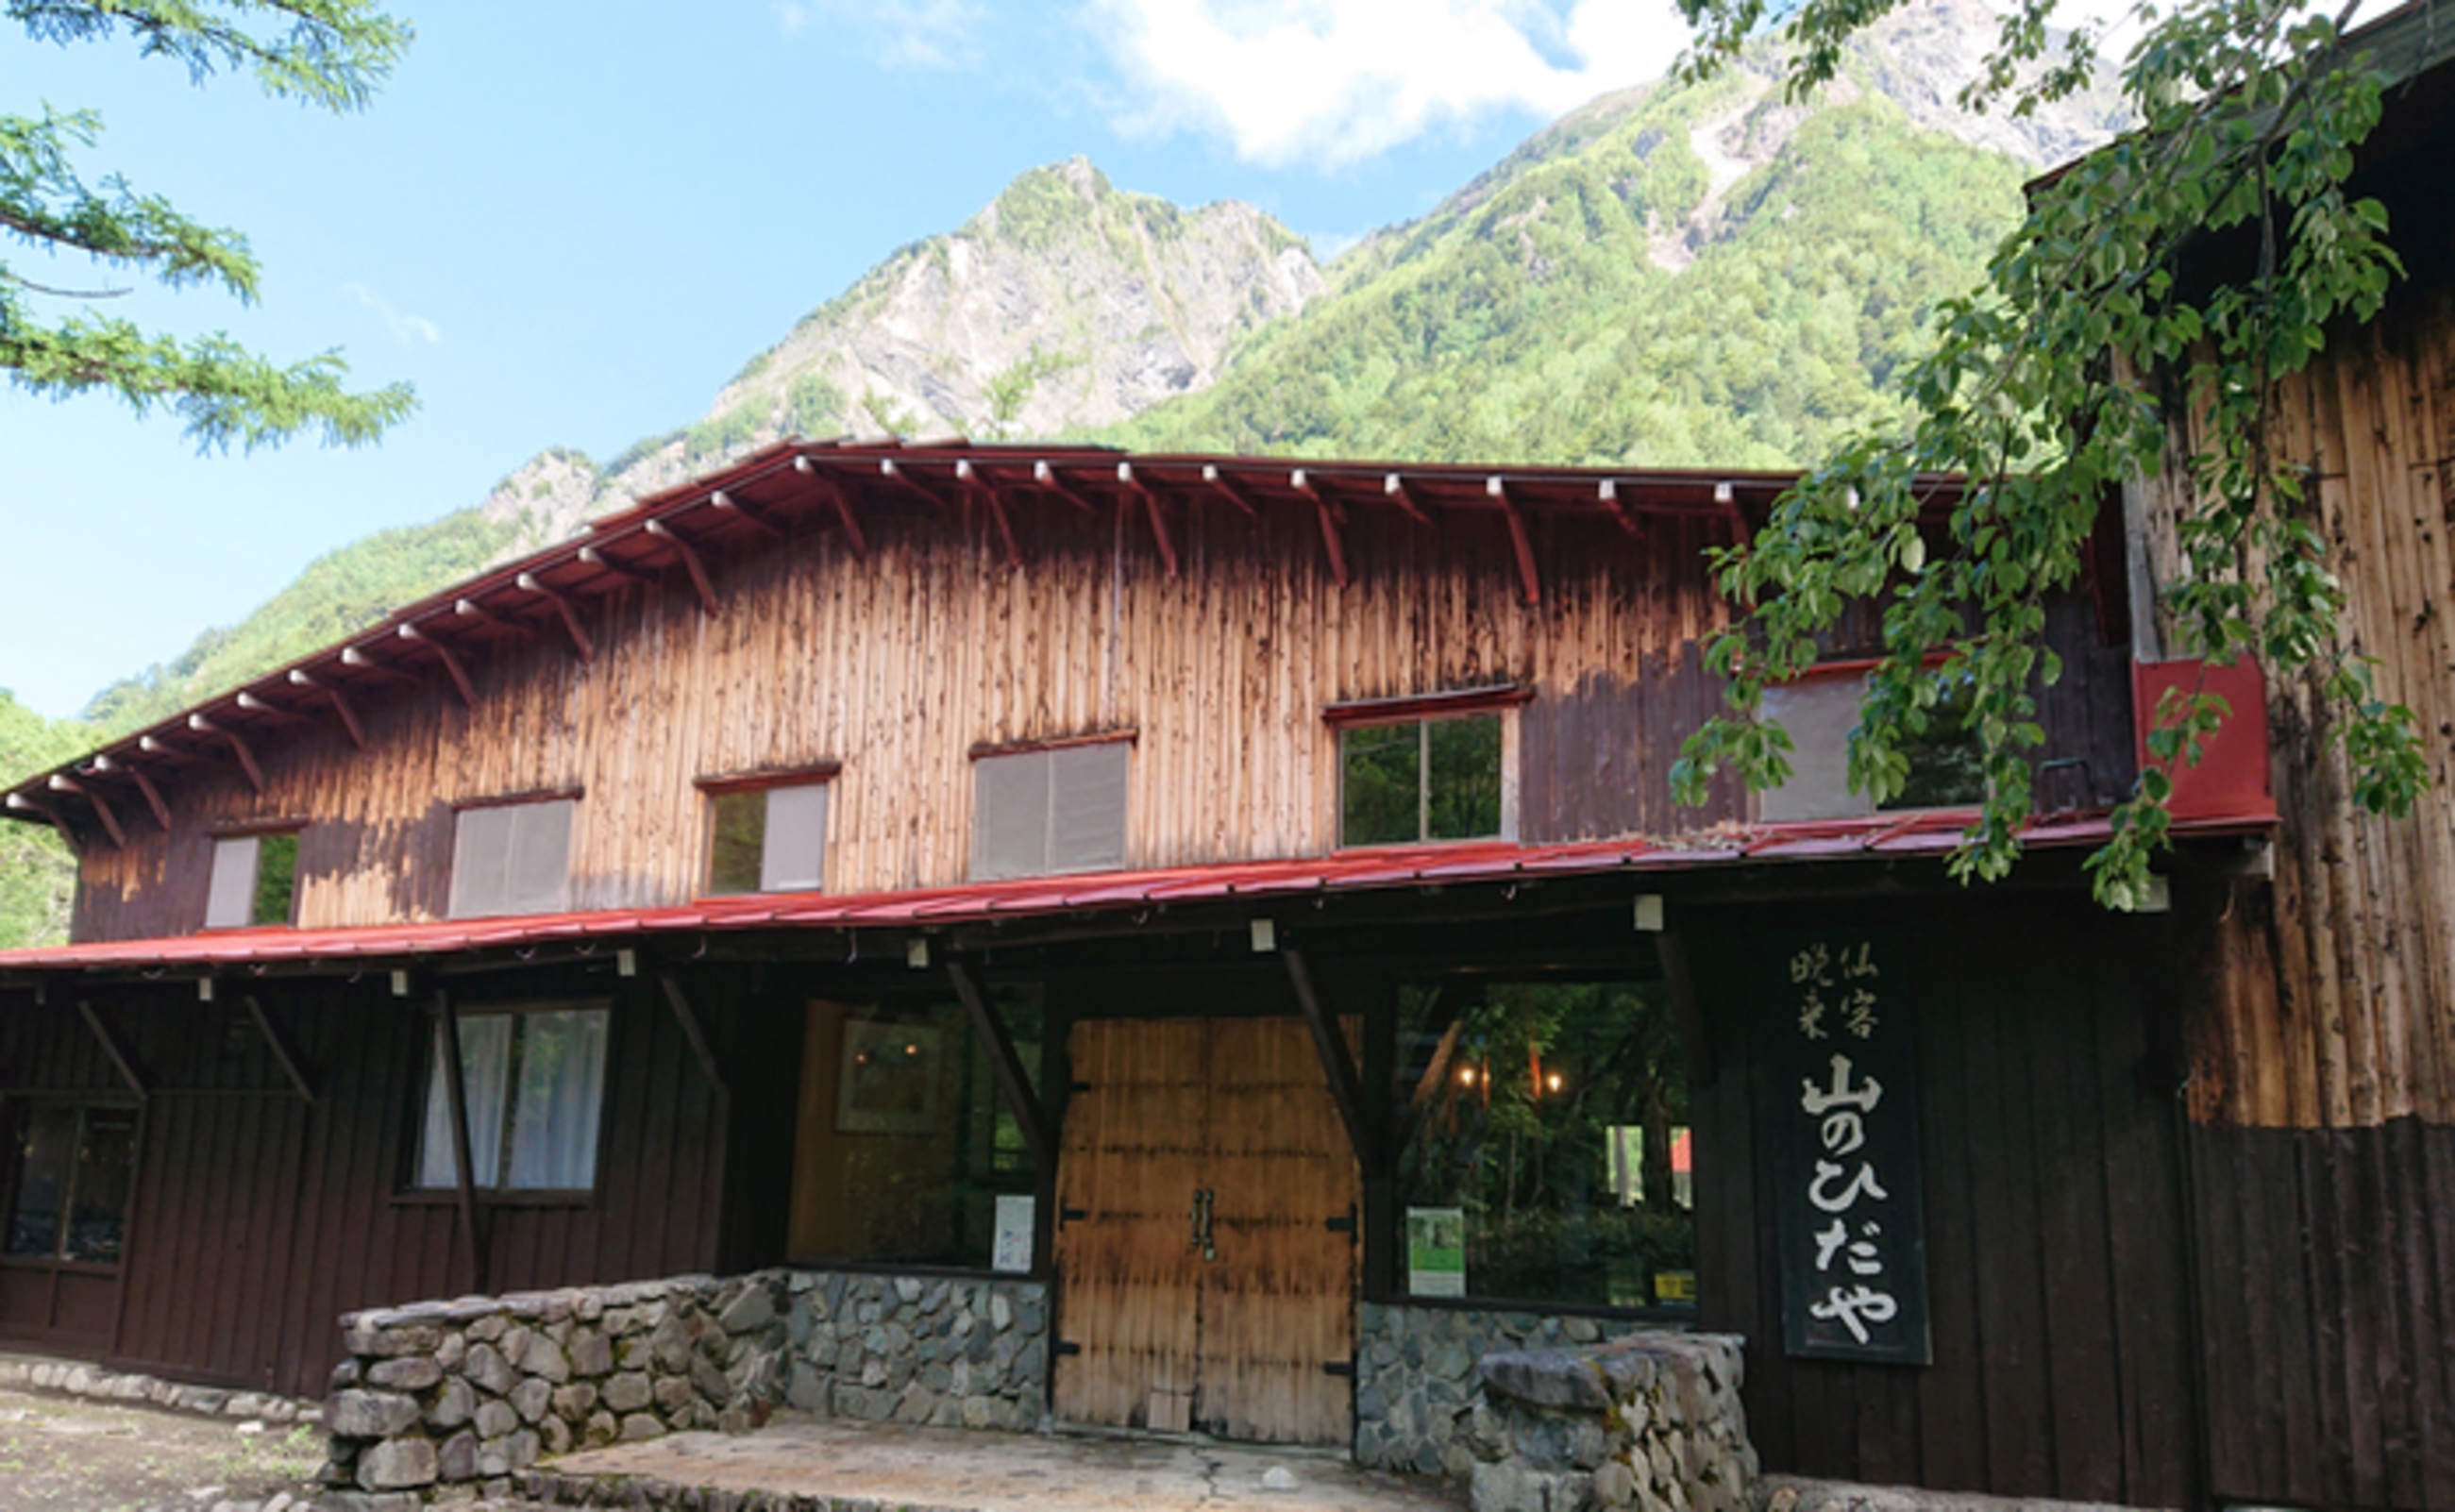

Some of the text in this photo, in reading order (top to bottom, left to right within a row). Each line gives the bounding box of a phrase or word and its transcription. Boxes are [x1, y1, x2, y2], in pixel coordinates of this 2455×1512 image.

[1801, 1055, 1898, 1345] 山のひだや
